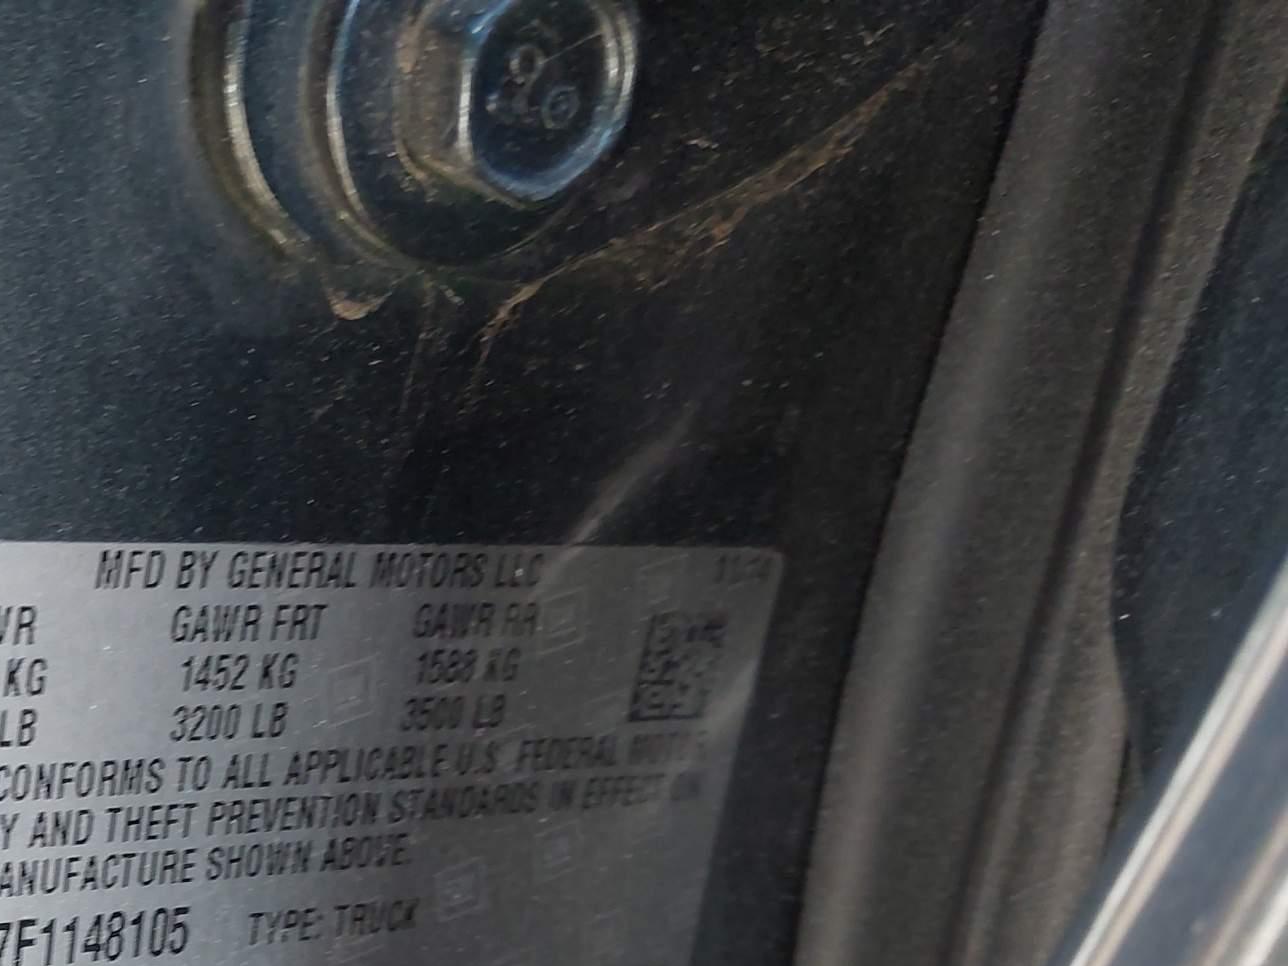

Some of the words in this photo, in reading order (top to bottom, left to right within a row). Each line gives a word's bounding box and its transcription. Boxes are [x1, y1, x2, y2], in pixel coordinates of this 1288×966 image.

[95, 550, 165, 590] MFD
[177, 549, 218, 588] BY
[228, 552, 355, 588] GENERAL
[370, 552, 485, 588] MOTORS
[495, 554, 545, 587] LLC
[171, 604, 261, 643] GAWR
[274, 603, 327, 639] FRT
[415, 603, 494, 638] GAWR
[2, 659, 47, 697] KG
[180, 653, 249, 692] 1452
[259, 653, 298, 689] KG
[484, 648, 521, 682] KG
[169, 704, 243, 742] 3200
[251, 702, 287, 738] LB
[400, 697, 462, 731] 3500
[473, 693, 508, 729] LB
[179, 756, 211, 794] TO
[221, 753, 272, 789] ALL
[285, 743, 447, 785] APPLICABLE
[512, 737, 617, 771] FEDERAL
[28, 809, 94, 849] AND
[105, 803, 198, 844] THEFT
[206, 790, 376, 835] PREVENTION
[392, 780, 540, 824] STANDARDS
[207, 840, 312, 881] SHOWN
[249, 907, 322, 946] TYPE:
[335, 900, 418, 936] TRUCK
